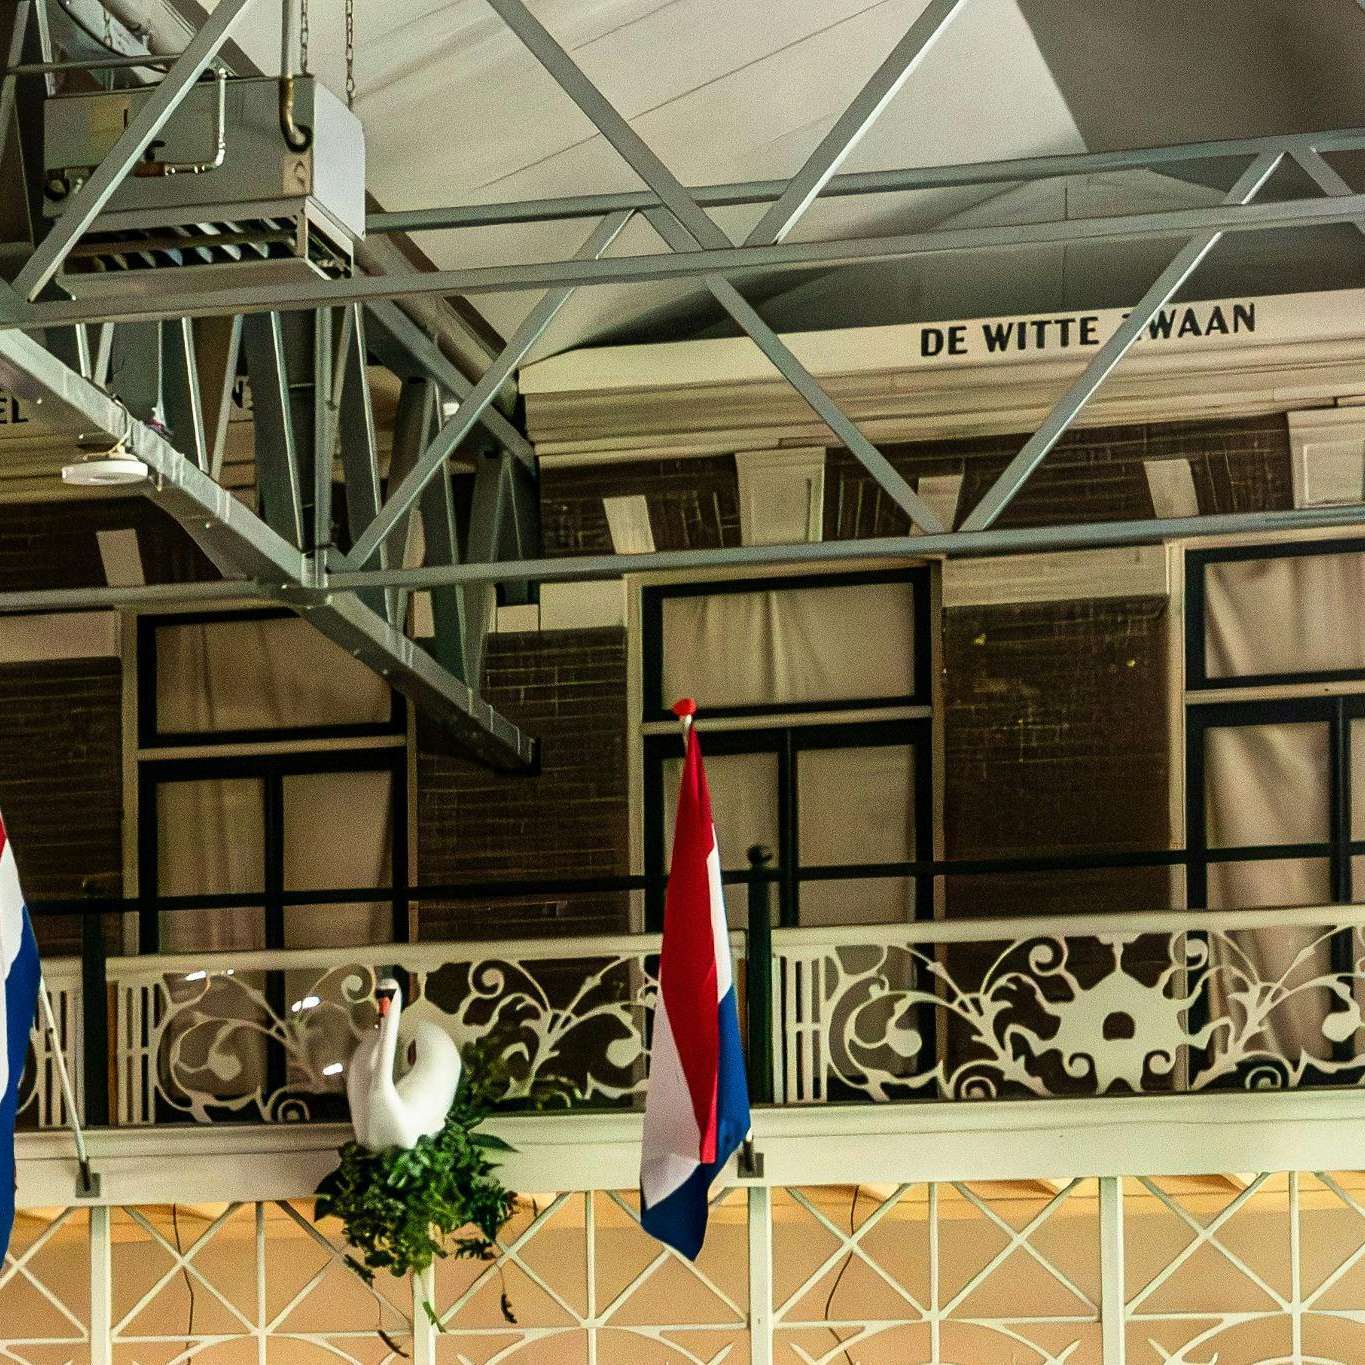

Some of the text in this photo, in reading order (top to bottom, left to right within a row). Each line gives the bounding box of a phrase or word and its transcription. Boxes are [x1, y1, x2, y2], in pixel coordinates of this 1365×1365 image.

[921, 303, 1255, 356] DE WITTE WAAN
